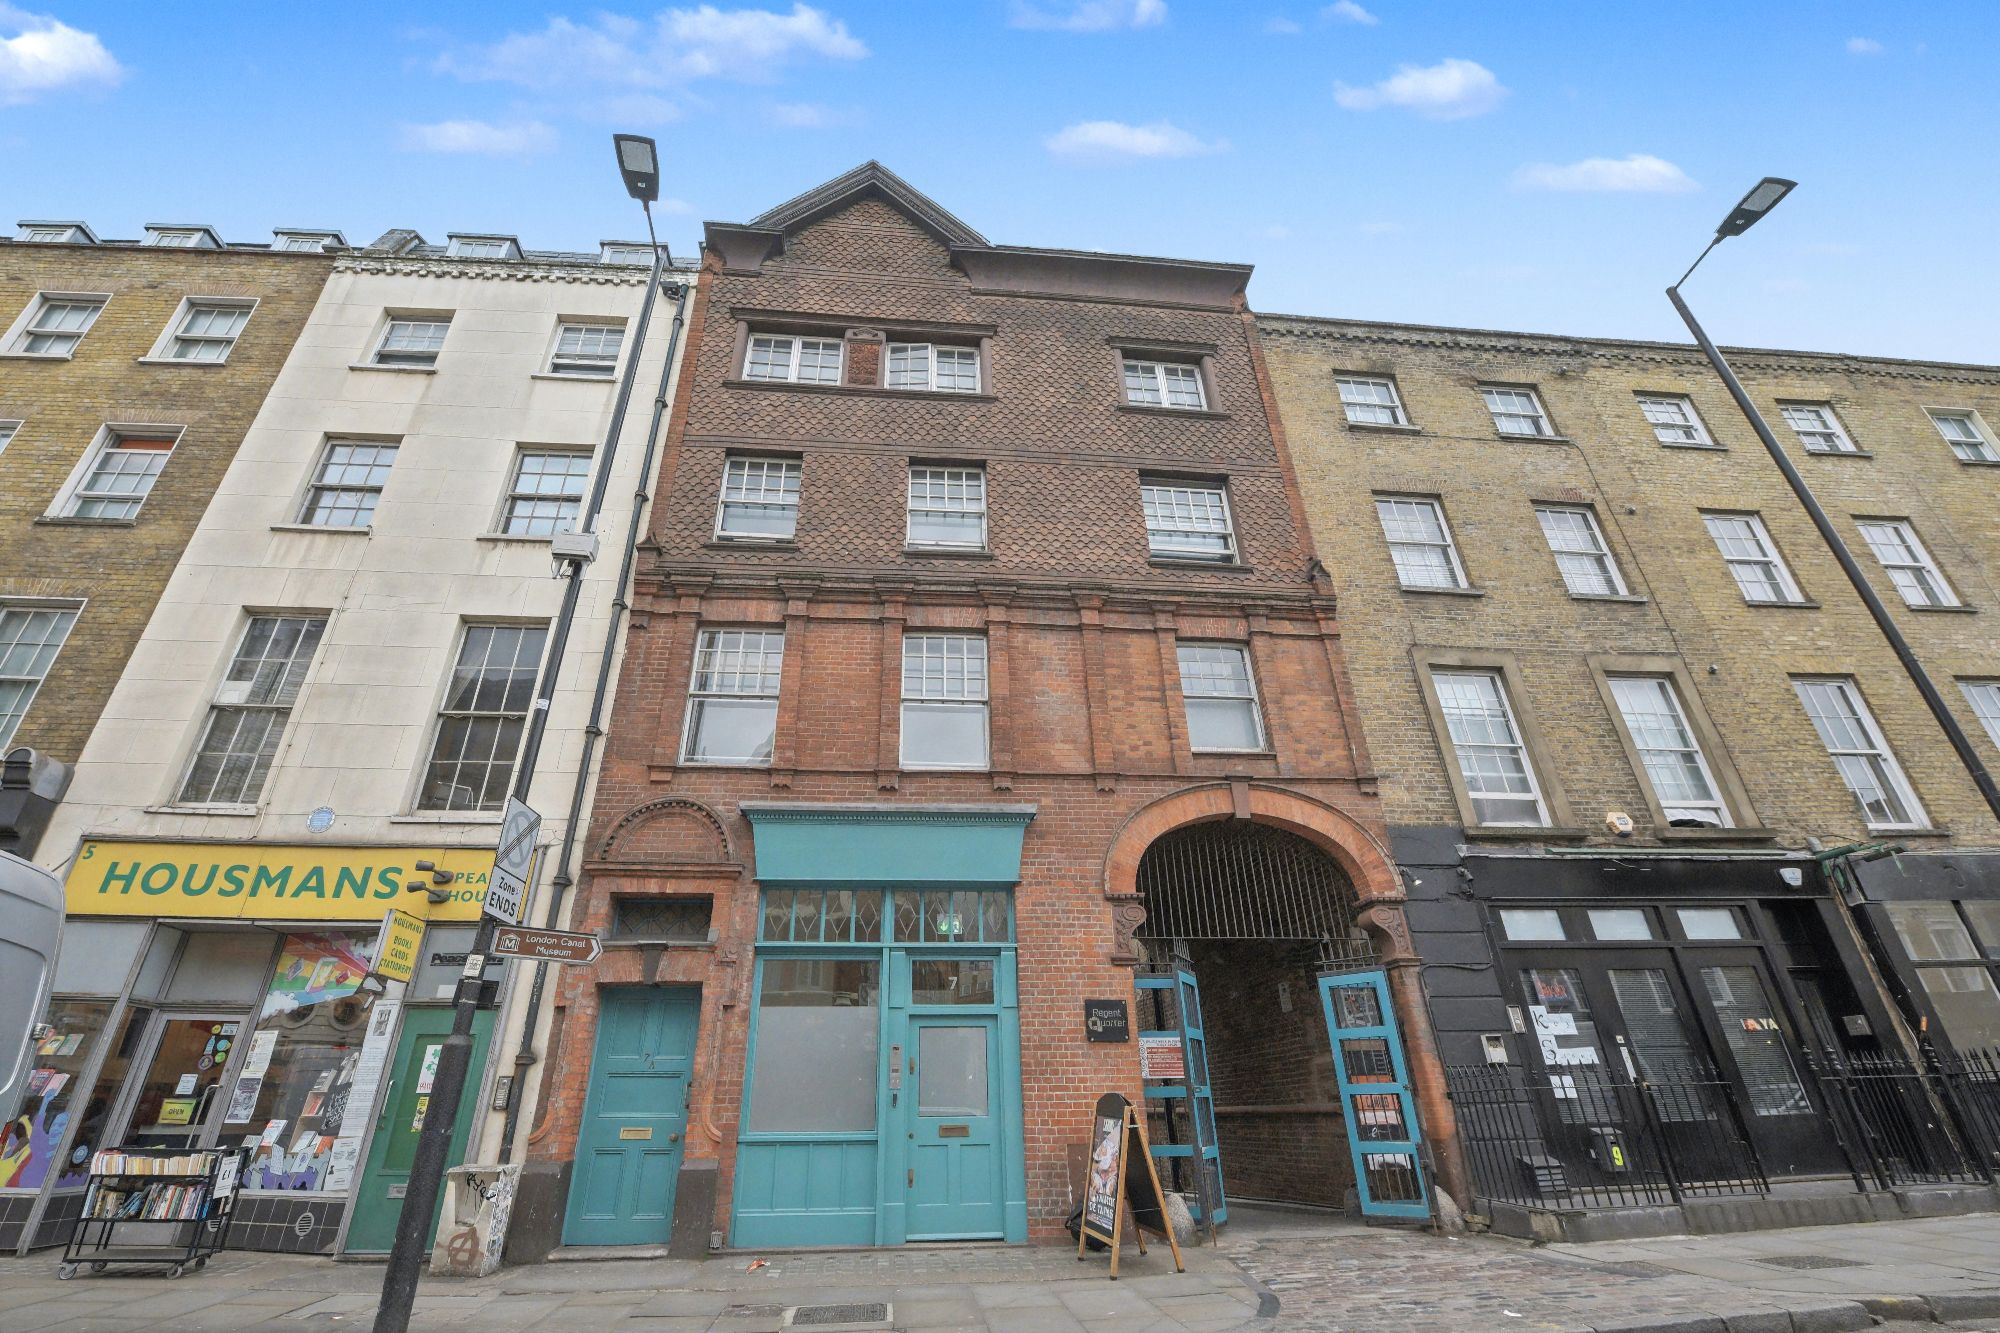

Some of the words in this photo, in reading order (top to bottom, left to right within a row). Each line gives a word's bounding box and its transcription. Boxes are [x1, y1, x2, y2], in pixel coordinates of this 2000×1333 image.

[82, 844, 97, 860] 5
[98, 861, 403, 900] HOUSMANS
[454, 872, 488, 884] PEA
[498, 876, 516, 896] Zone
[488, 891, 517, 917] ENDS
[393, 916, 424, 935] HOUSMANS
[393, 935, 412, 949] BOOKS
[525, 933, 557, 944] London
[560, 937, 586, 948] Canal
[535, 945, 571, 957] Museum
[948, 976, 958, 990] 7
[1092, 1008, 1122, 1019] Regent
[1087, 1016, 1127, 1033] Quarter
[168, 1107, 185, 1116] OPEN
[1612, 1146, 1624, 1166] 9
